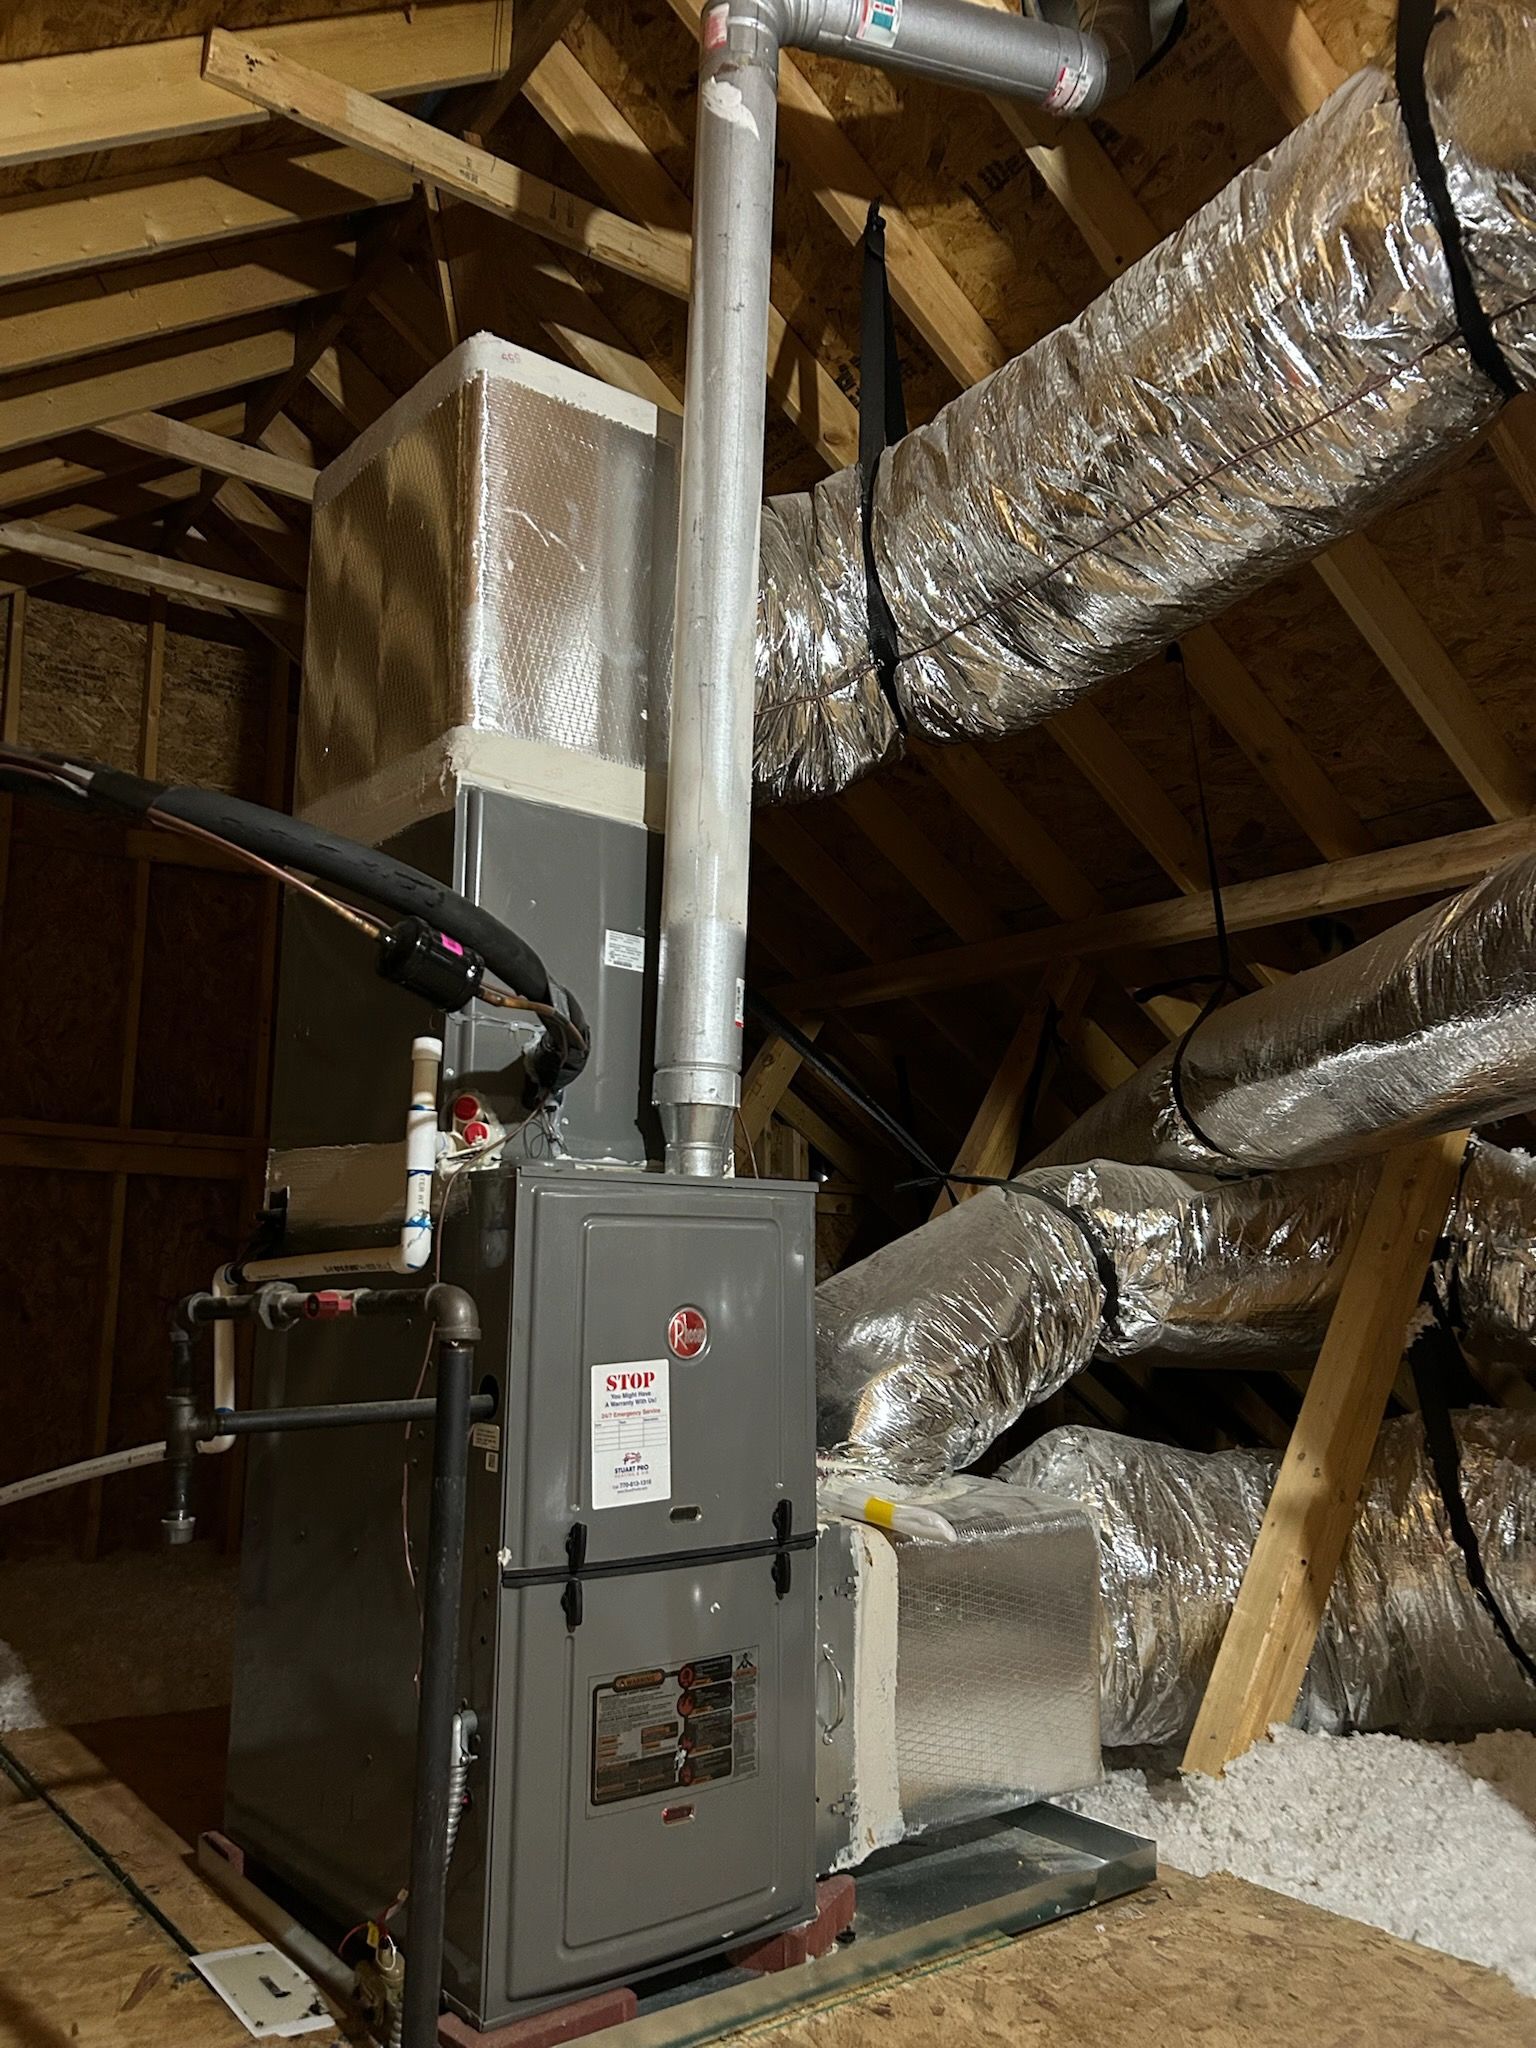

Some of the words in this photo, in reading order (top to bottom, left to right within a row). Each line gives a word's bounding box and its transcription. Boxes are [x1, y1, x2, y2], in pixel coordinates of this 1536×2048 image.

[606, 1371, 655, 1391] STOP
[622, 1391, 637, 1400] Might
[613, 1410, 641, 1418] Emergency
